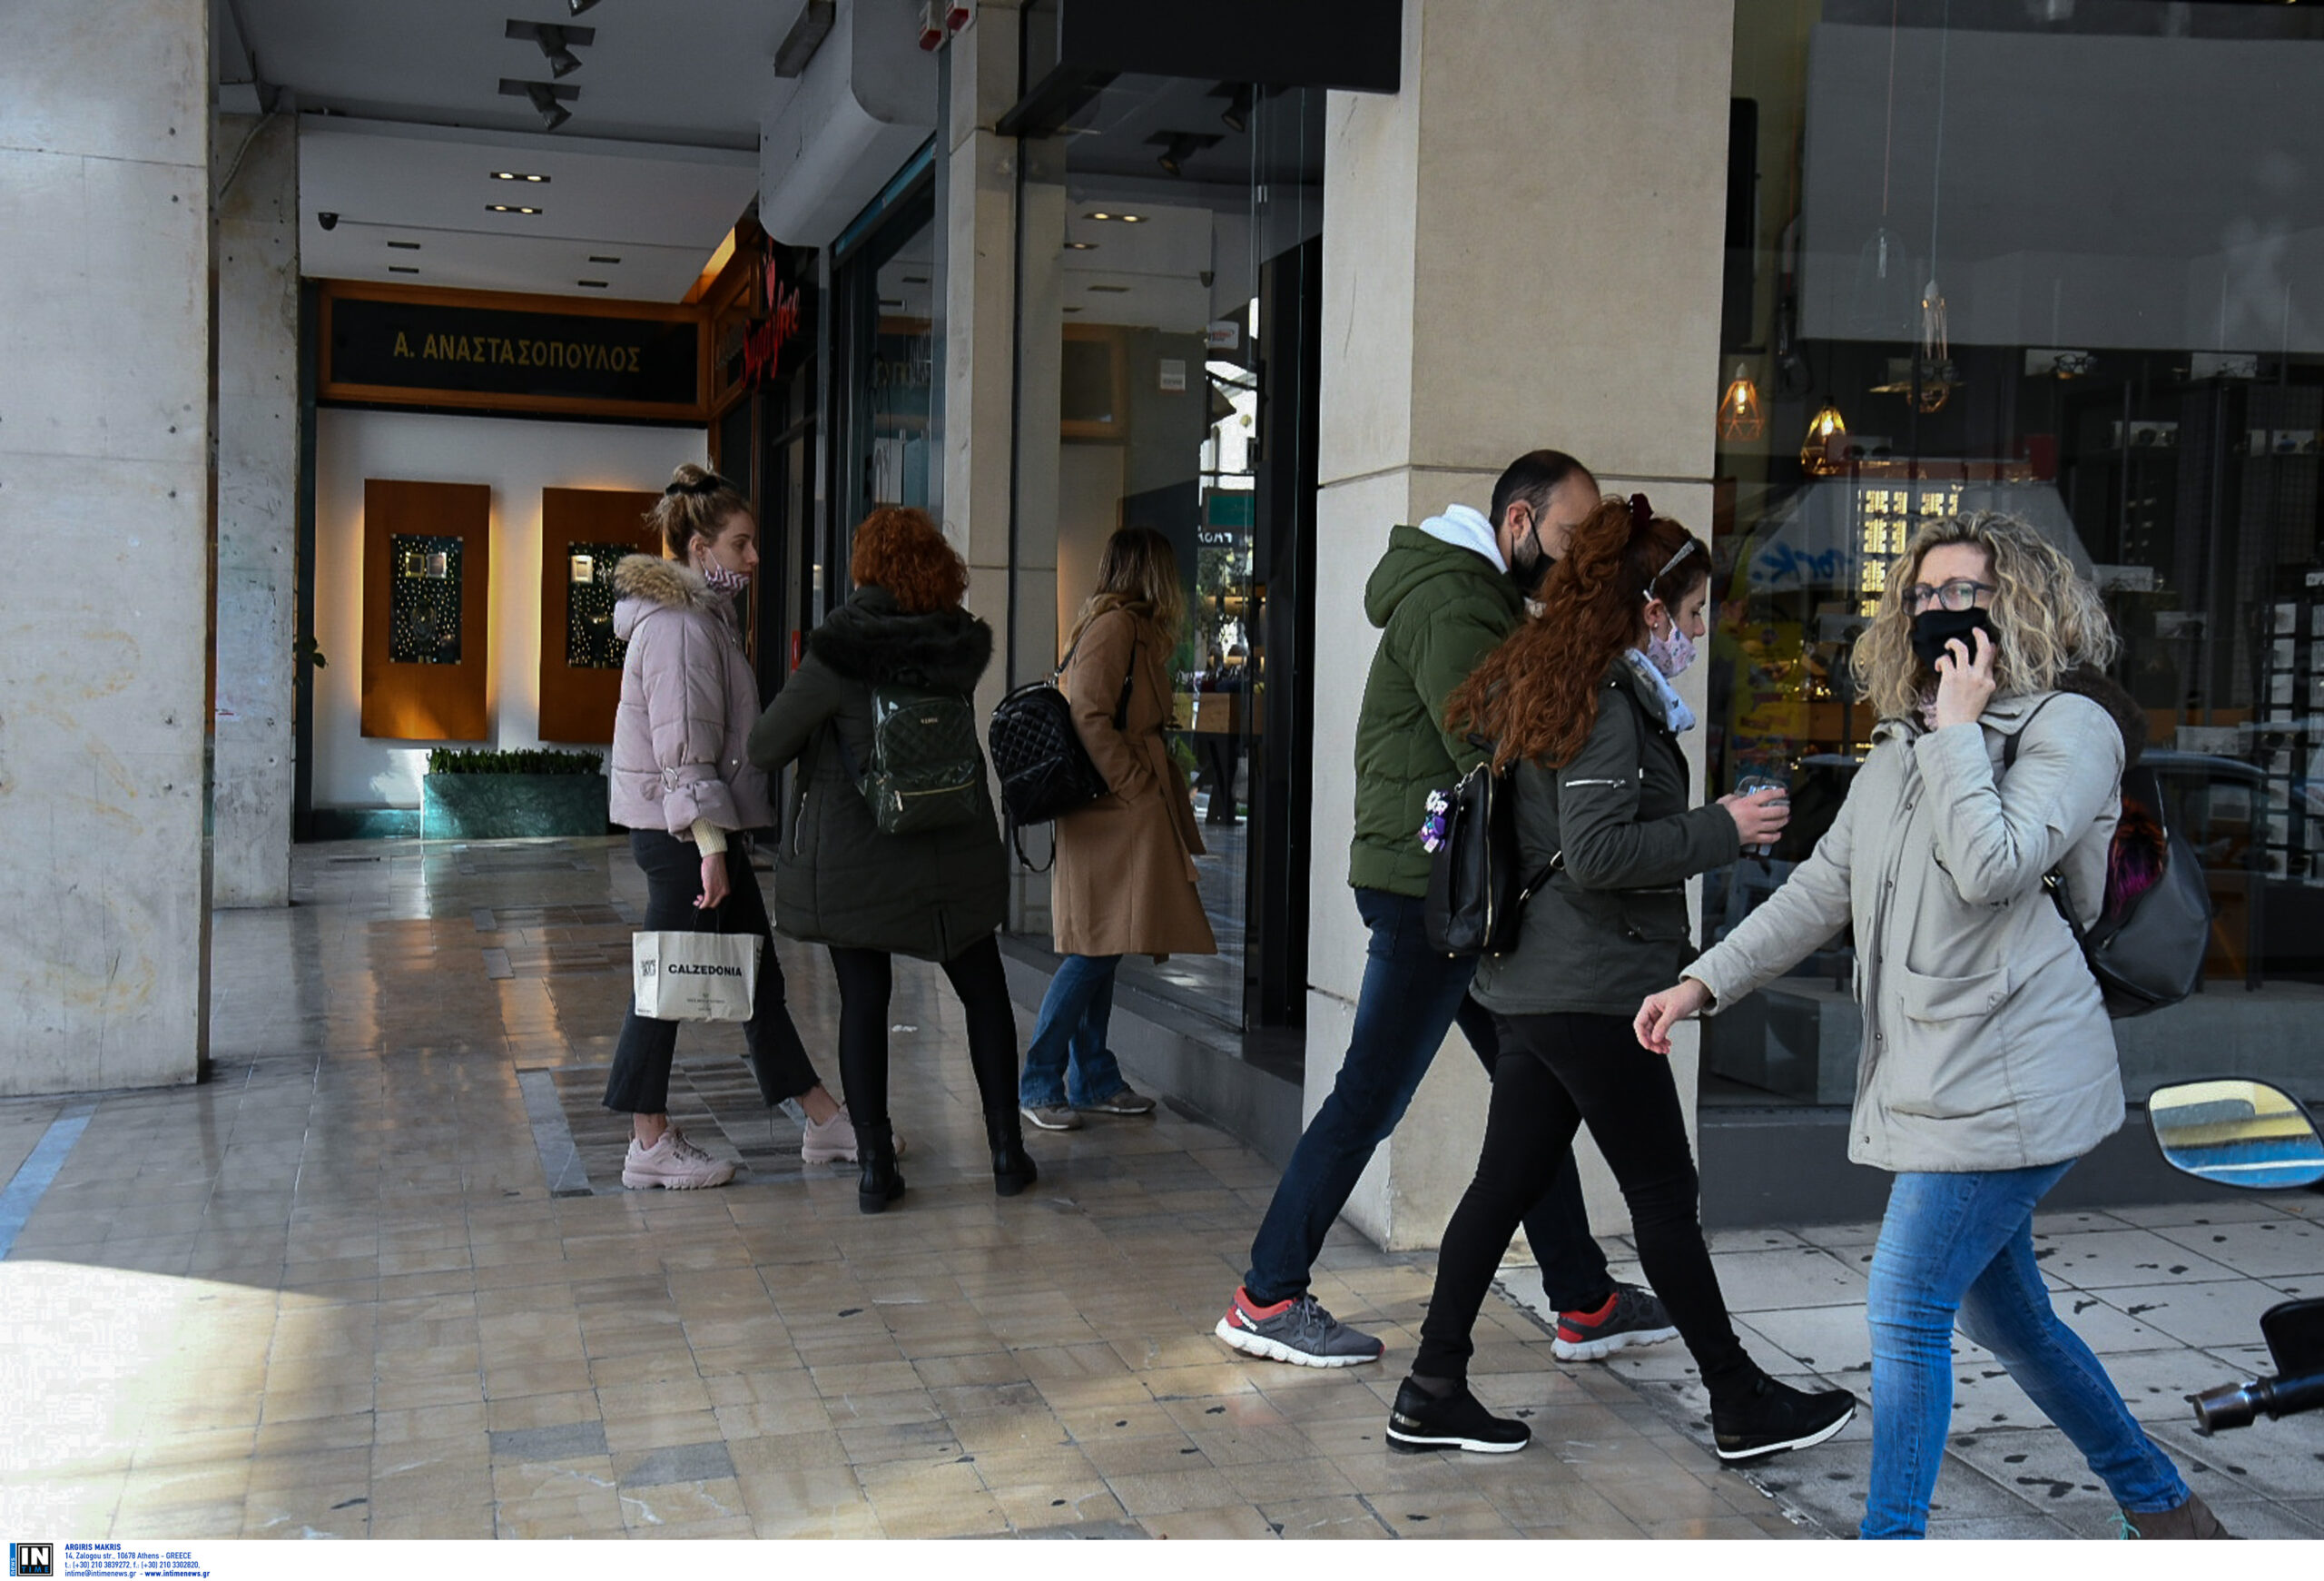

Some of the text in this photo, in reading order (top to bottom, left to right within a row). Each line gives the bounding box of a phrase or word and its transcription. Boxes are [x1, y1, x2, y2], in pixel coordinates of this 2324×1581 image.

[393, 331, 640, 372] Α. ΑΝΑΣΤΑΣΟΠΟΥΛΟΣ
[668, 963, 743, 977] CALZEDONIA
